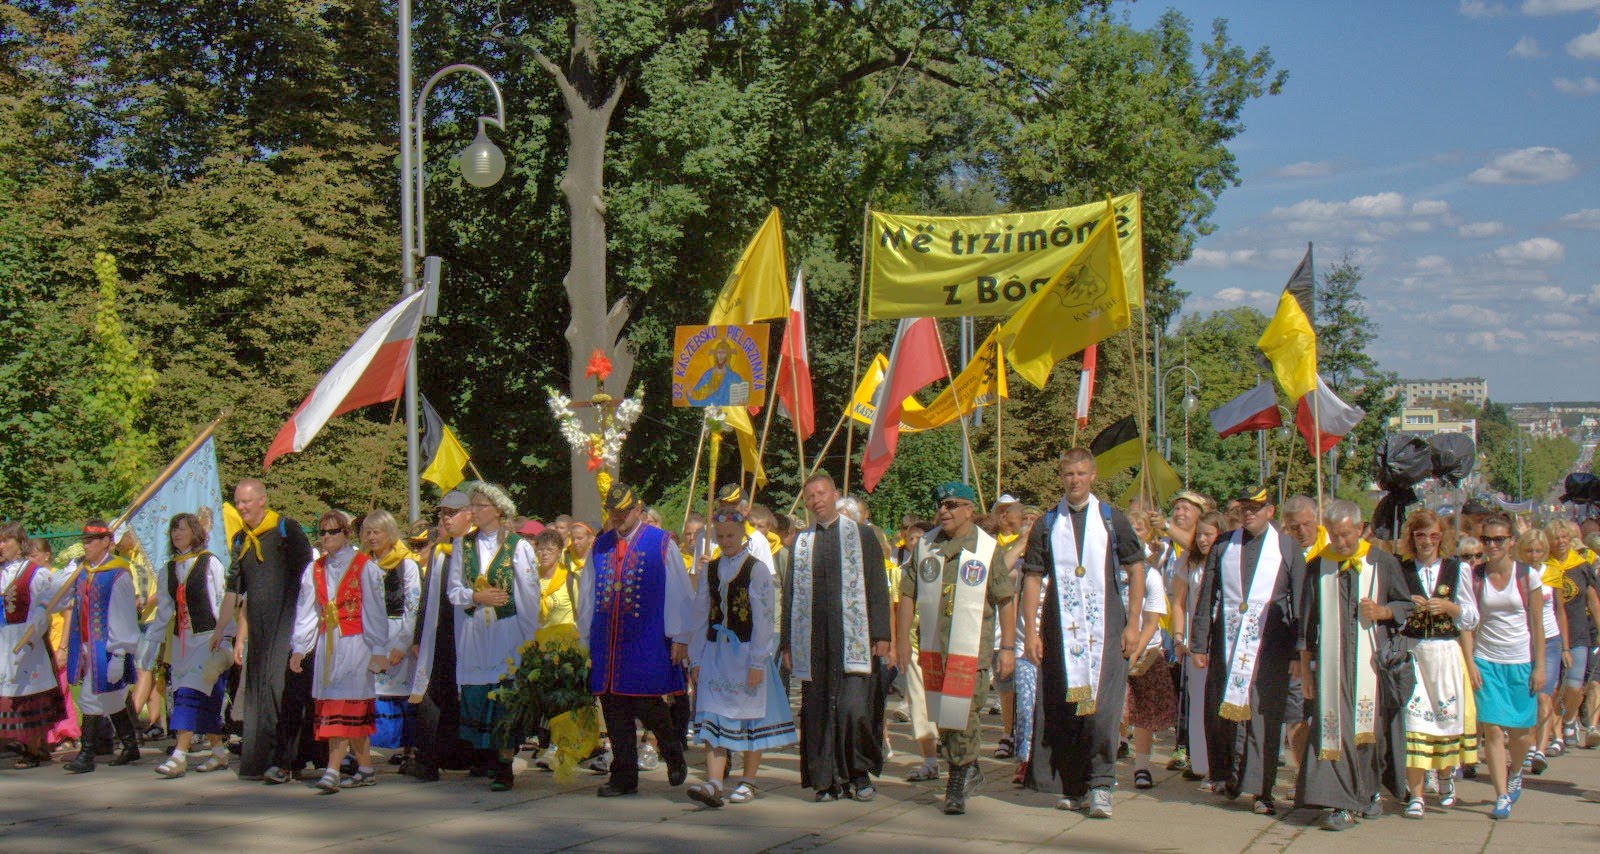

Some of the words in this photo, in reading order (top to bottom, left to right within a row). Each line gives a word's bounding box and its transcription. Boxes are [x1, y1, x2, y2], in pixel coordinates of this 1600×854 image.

[881, 222, 935, 253] Më
[943, 284, 962, 306] z
[672, 383, 684, 399] 32
